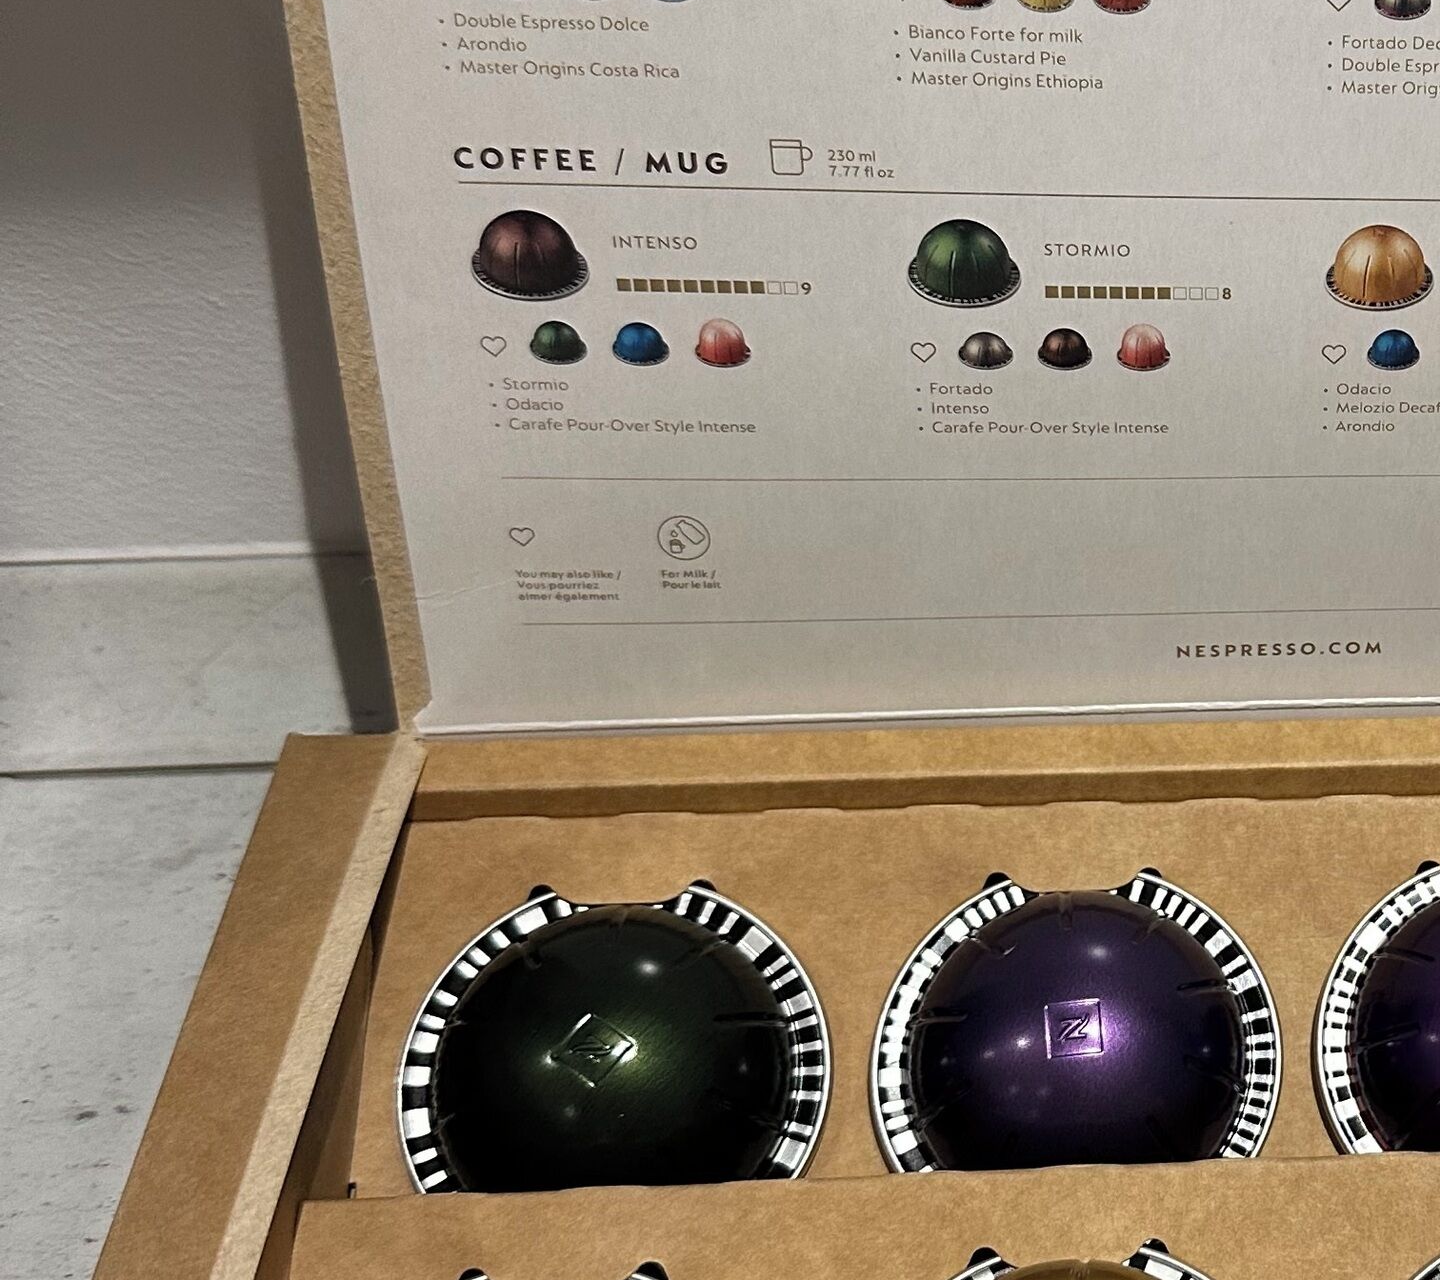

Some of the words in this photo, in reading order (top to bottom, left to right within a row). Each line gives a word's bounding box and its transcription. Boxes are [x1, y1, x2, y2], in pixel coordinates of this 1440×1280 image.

[454, 13, 516, 30] Double
[521, 14, 595, 33] Espresso
[600, 16, 650, 32] Dolce
[908, 25, 965, 41] Bianco
[970, 26, 1015, 42] Forte
[1019, 27, 1044, 42] for
[1048, 28, 1083, 43] milk
[457, 37, 528, 53] Arondio
[1342, 35, 1407, 51] Fortado
[909, 48, 966, 64] Vanilla
[970, 49, 1035, 65] Custard
[1039, 51, 1067, 66] Pie
[460, 60, 518, 76] Master
[523, 61, 585, 81] Origins
[589, 63, 639, 79] Costa
[643, 64, 680, 80] Rica
[1342, 58, 1401, 73] Double
[911, 72, 968, 87] Master
[972, 72, 1032, 91] Origins
[1036, 74, 1103, 92] Ethiopia
[1341, 81, 1398, 96] Master
[453, 146, 597, 172] COFFEE
[645, 151, 729, 175] MUG
[827, 149, 856, 163] 230
[859, 150, 876, 163] ml
[829, 165, 860, 178] 7.77
[864, 166, 874, 179] fl
[877, 169, 895, 179] oz
[613, 235, 698, 250] INTENSO
[1044, 243, 1131, 258] STORMIO
[801, 281, 812, 296] 9
[1222, 287, 1232, 300] 8
[503, 377, 569, 392] Stormio
[930, 383, 993, 396] Fortado
[1336, 383, 1392, 396] Odacio
[506, 398, 564, 412] Odacio
[931, 402, 989, 415] Intenso
[1336, 402, 1395, 414] Melozio
[509, 418, 563, 432] Carafe
[568, 419, 650, 434] Pour-Over
[655, 420, 695, 437] Style
[699, 421, 757, 435] Intense
[932, 422, 984, 435] Carafe
[988, 422, 1068, 435] Pour-Over
[1072, 422, 1110, 437] Style
[1114, 422, 1169, 435] Intense
[1335, 420, 1395, 433] Arondio
[1177, 642, 1382, 658] NESPRESSO.COM
